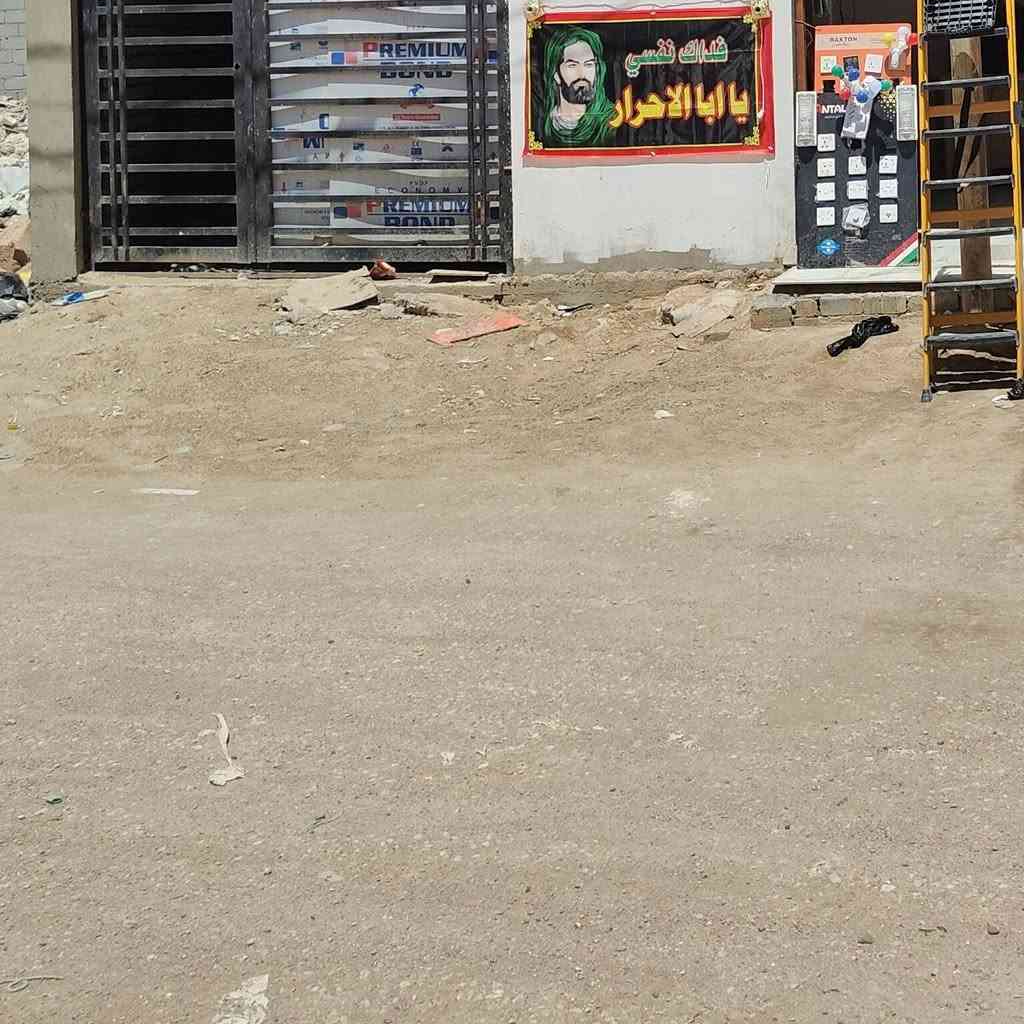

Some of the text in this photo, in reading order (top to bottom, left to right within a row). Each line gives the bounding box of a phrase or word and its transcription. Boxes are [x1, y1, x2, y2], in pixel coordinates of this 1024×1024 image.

[362, 42, 468, 58] PREMIUM
[624, 37, 676, 78] نفسي
[367, 199, 472, 213] PREMIUM
